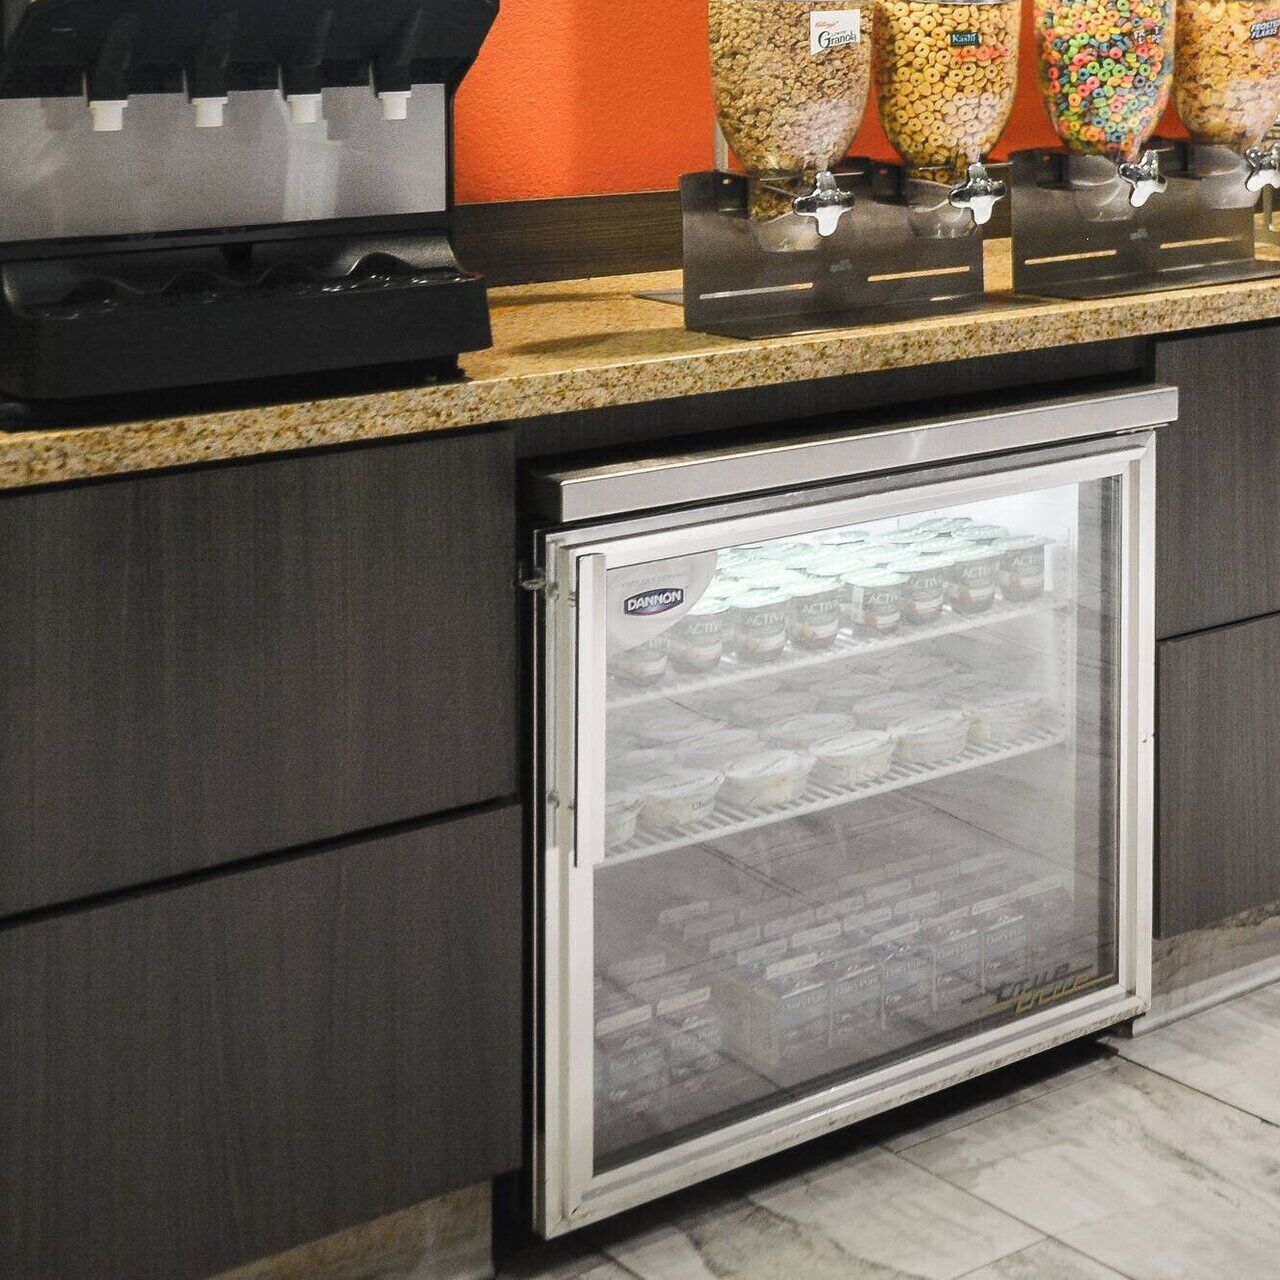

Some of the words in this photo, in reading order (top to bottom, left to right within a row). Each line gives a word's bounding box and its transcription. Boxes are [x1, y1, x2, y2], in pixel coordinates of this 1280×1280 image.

[817, 30, 857, 49] Granola
[952, 32, 977, 43] Kashi
[627, 589, 683, 612] DANNON
